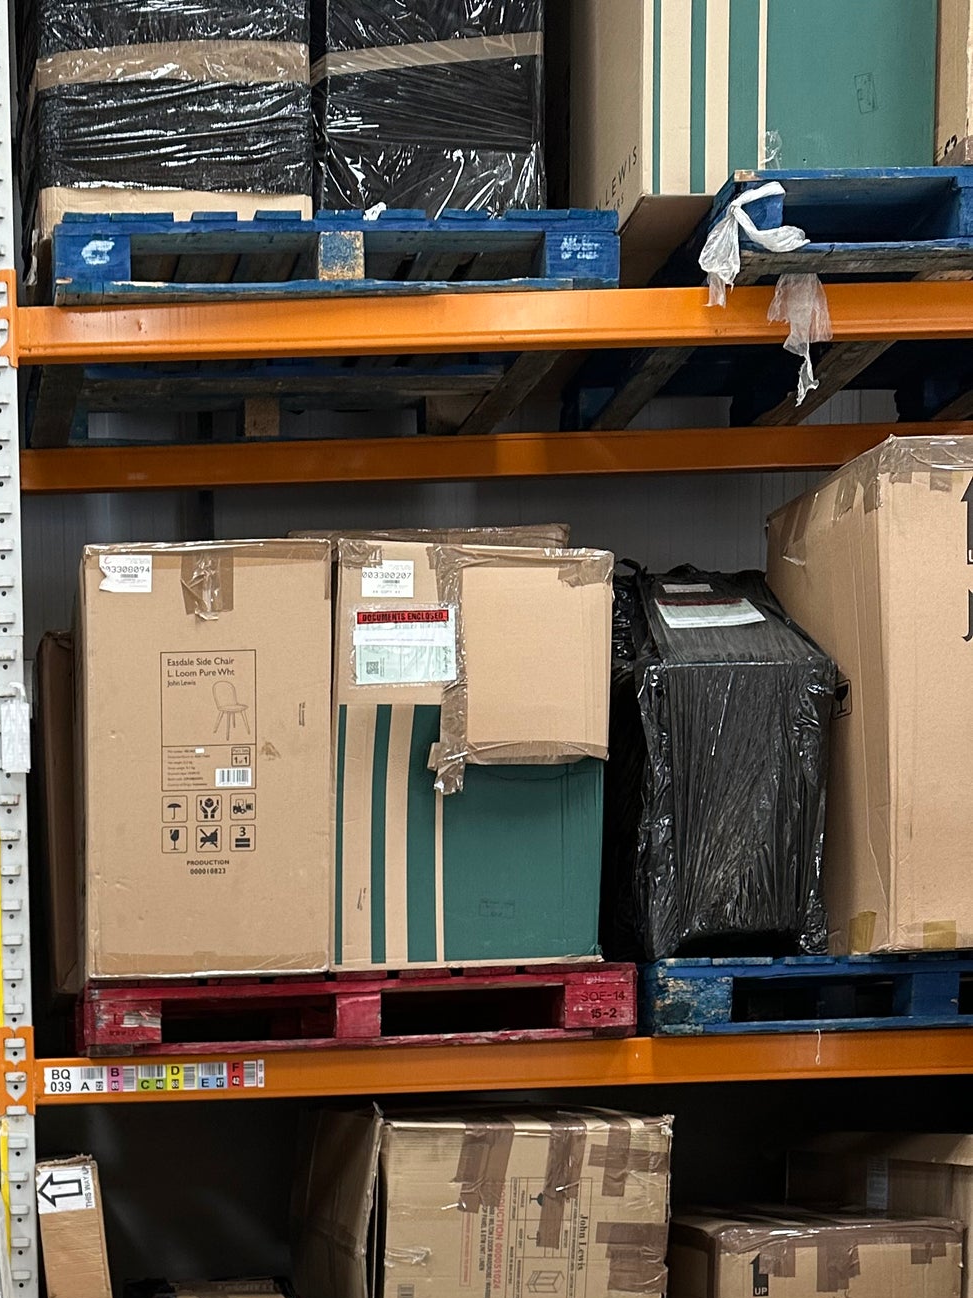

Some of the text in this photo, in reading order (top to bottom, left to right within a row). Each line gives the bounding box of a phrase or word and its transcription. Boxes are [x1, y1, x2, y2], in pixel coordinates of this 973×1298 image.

[606, 146, 637, 206] LEWIS
[362, 612, 443, 621] DOCUMENTS ENCLOSED
[168, 658, 194, 666] Easdale
[214, 657, 234, 665] Chair
[239, 827, 246, 836] 3
[591, 1008, 617, 1018] 15-2
[171, 1066, 180, 1075] D
[232, 1063, 240, 1072] F
[52, 1069, 70, 1080] BQ
[111, 1068, 119, 1077] B
[50, 1082, 71, 1092] 039
[81, 1082, 90, 1091] A
[141, 1080, 149, 1089] C
[202, 1078, 209, 1088] E
[84, 1192, 93, 1208] THIS
[577, 1214, 588, 1270] John Lewis
[493, 1242, 503, 1289] 000051024
